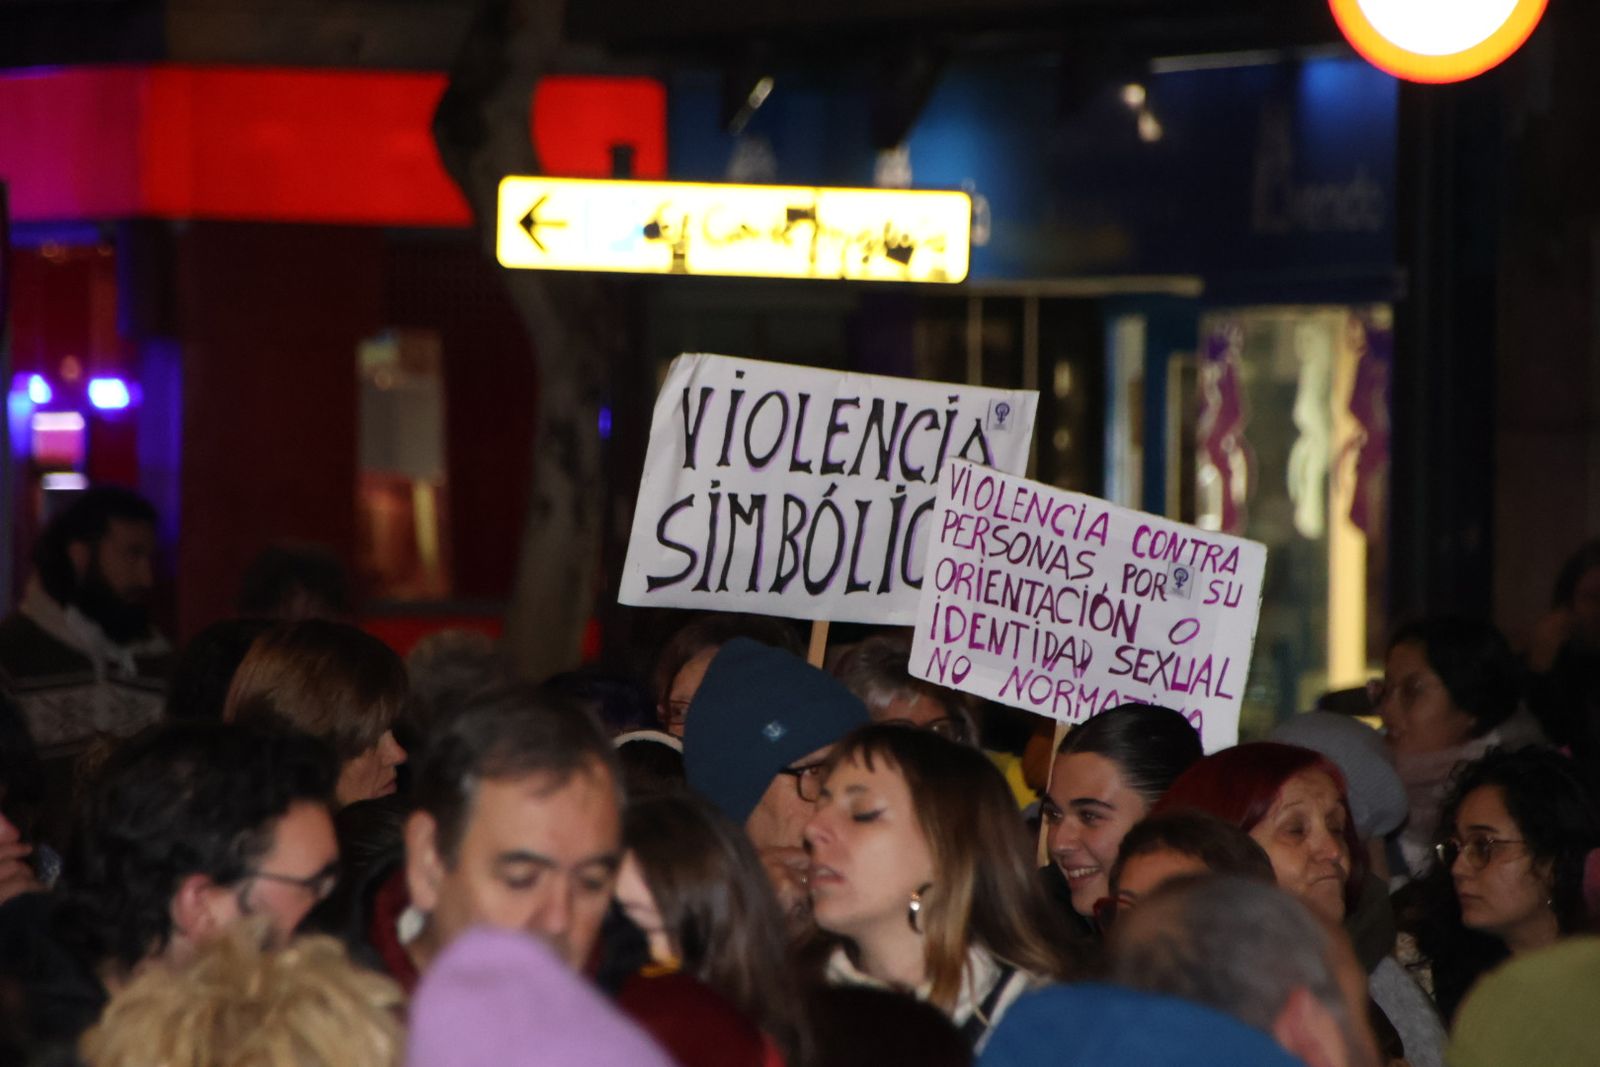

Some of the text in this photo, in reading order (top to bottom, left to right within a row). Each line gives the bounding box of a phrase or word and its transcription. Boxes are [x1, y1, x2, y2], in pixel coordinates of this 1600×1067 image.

[646, 480, 937, 596] SIMBÓLIC
[941, 509, 1244, 608] PERSONAS POR SU
[951, 464, 1240, 575] VIOLENCIA CONTRA
[926, 647, 972, 684] NO
[930, 595, 1234, 700] IDENTIDAD SEXUAL
[1168, 617, 1200, 645] O
